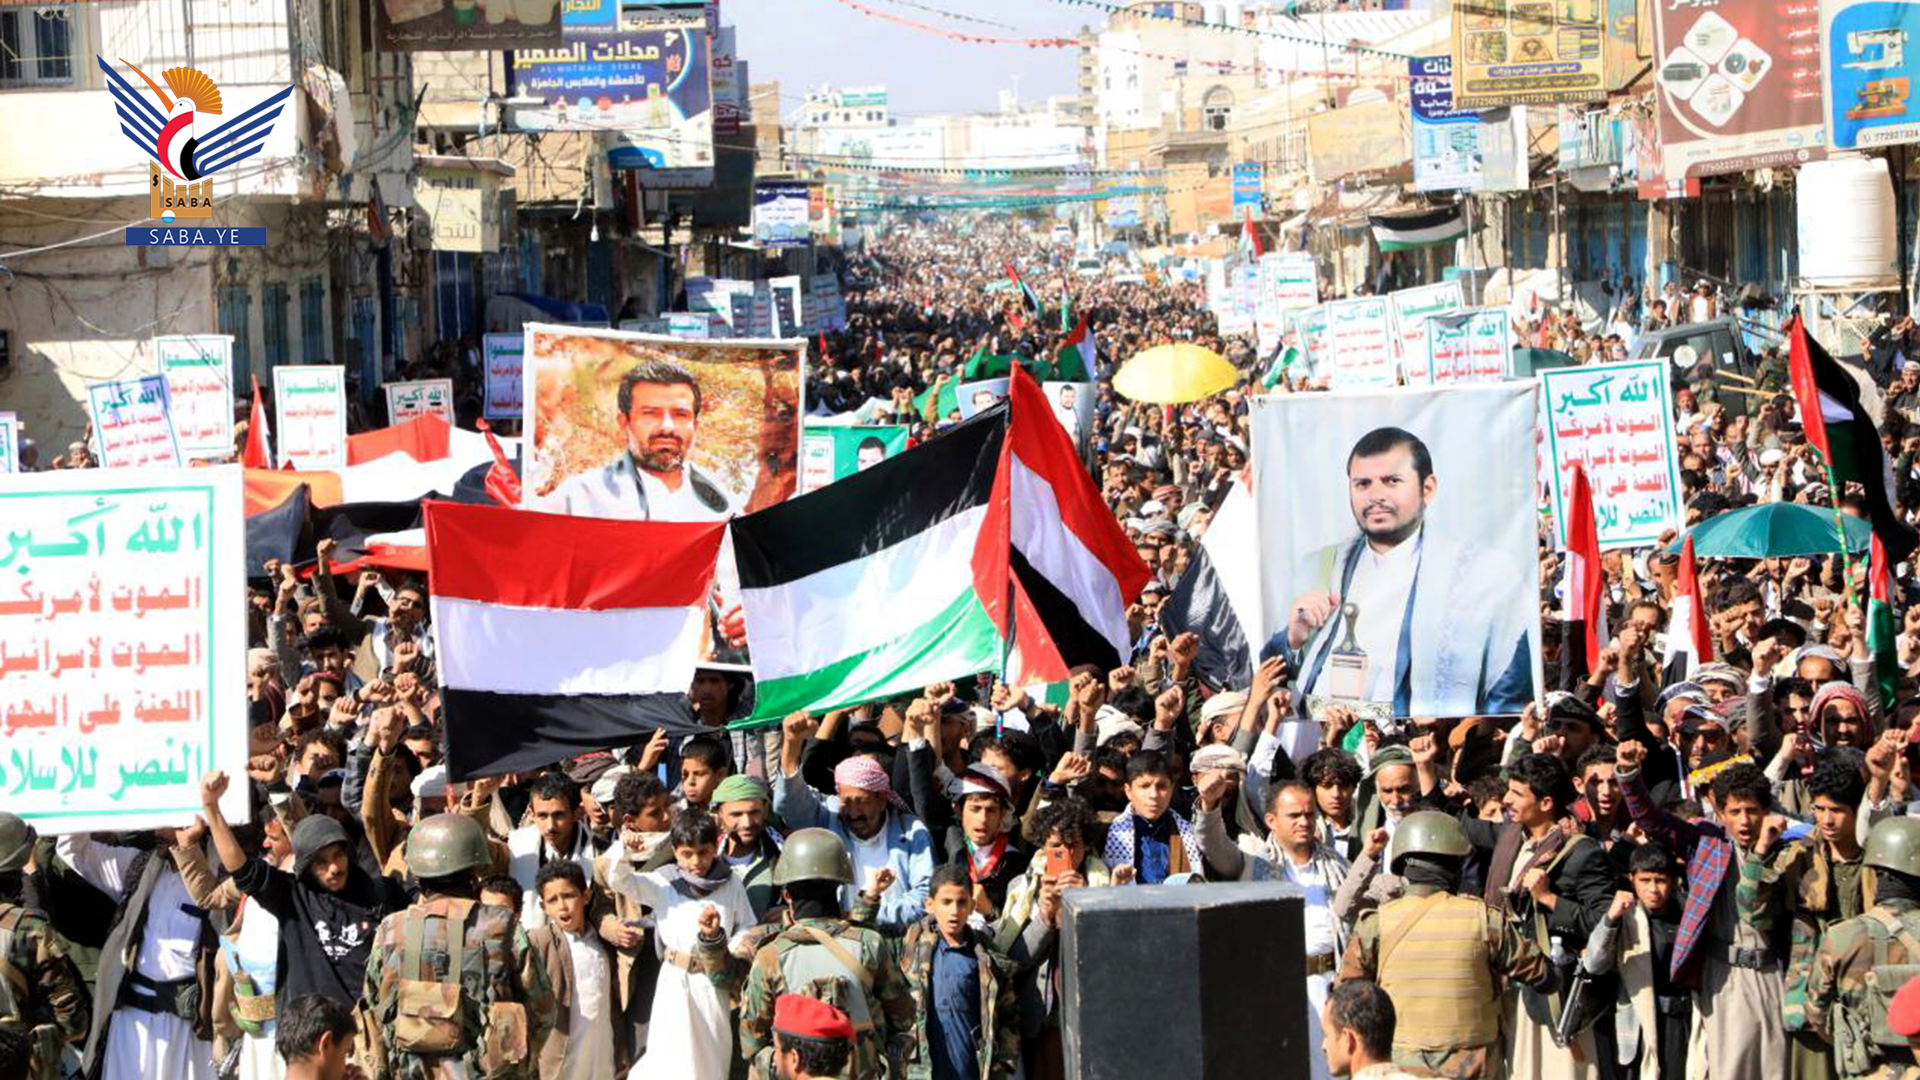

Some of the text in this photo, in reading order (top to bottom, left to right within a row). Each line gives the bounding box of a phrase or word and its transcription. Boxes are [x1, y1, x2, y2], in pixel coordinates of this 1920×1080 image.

[513, 39, 660, 71] محلات المتميز
[1477, 317, 1504, 336] الله
[139, 386, 161, 404] الله
[428, 386, 447, 402] الله
[1556, 373, 1658, 416] الله أكبر
[1556, 412, 1660, 440] الموت لأمريكا
[1560, 443, 1665, 472] الموت لإسرائيل
[1606, 476, 1628, 498] على
[1633, 473, 1668, 493] اللعنة
[1627, 498, 1670, 532] النصر
[0, 497, 201, 576] الله أكبر
[0, 572, 201, 622] الموت لأمريك
[111, 632, 201, 675] الموت
[0, 690, 201, 738] اللعنة على اليهو
[109, 737, 201, 801] النصر
